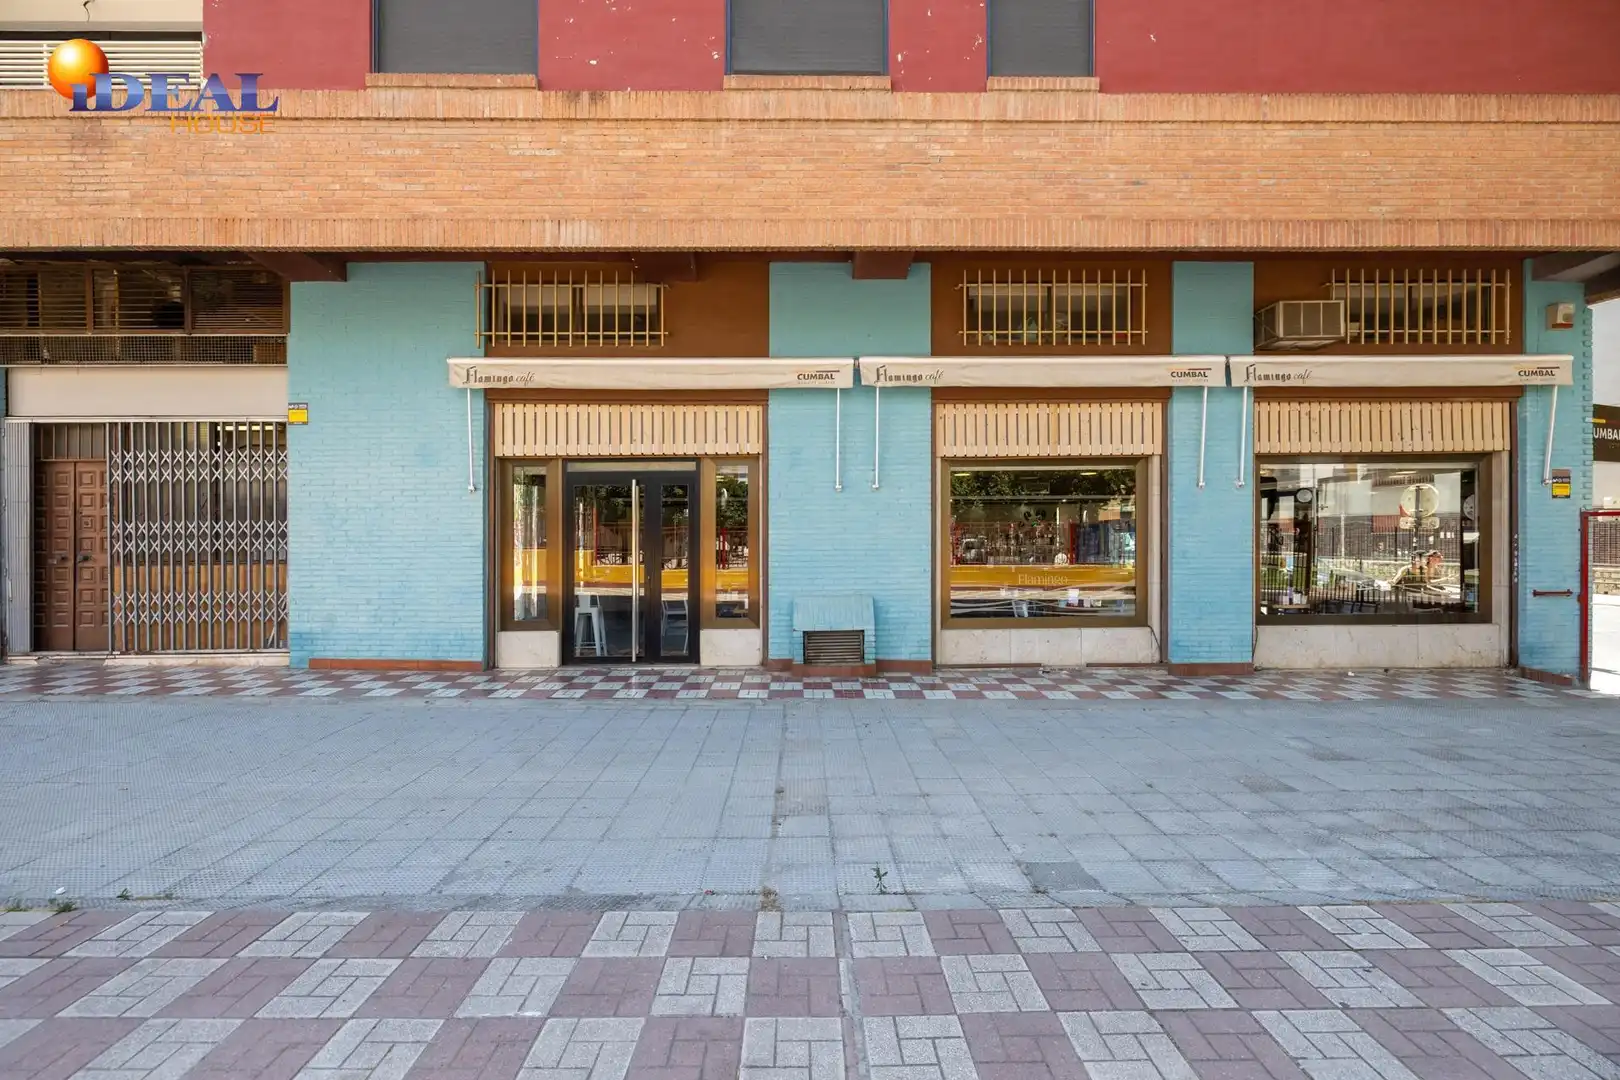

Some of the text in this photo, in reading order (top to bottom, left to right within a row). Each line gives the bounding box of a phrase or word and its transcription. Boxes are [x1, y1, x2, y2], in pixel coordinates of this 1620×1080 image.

[462, 366, 514, 385] Flamingo
[797, 373, 836, 381] CUMBAL
[874, 365, 945, 385] Flamingo café
[1243, 363, 1292, 383] Flamingo
[1593, 427, 1620, 440] UMBA
